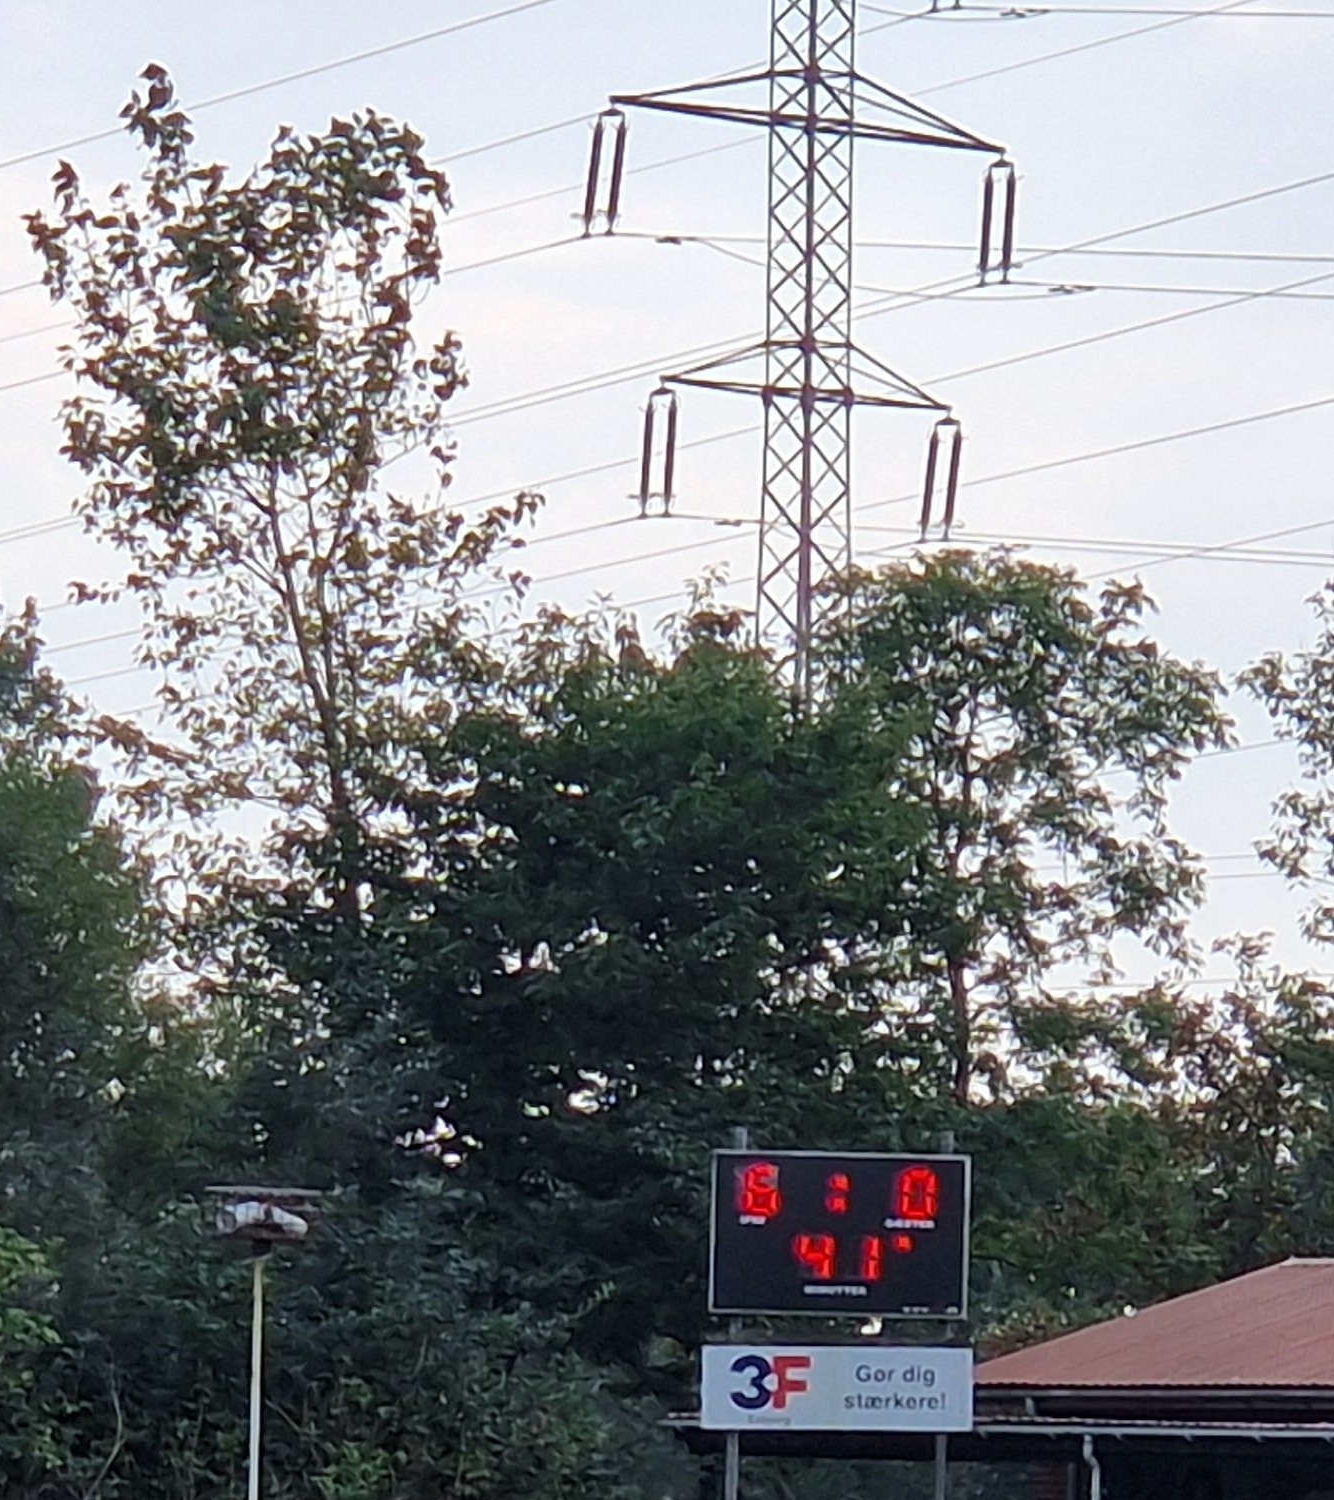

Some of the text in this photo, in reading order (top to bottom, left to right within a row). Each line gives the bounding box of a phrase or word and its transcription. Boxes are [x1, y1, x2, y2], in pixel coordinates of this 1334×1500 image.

[897, 1166, 939, 1219] 0
[729, 1354, 812, 1410] 3F
[902, 1365, 936, 1388] dig
